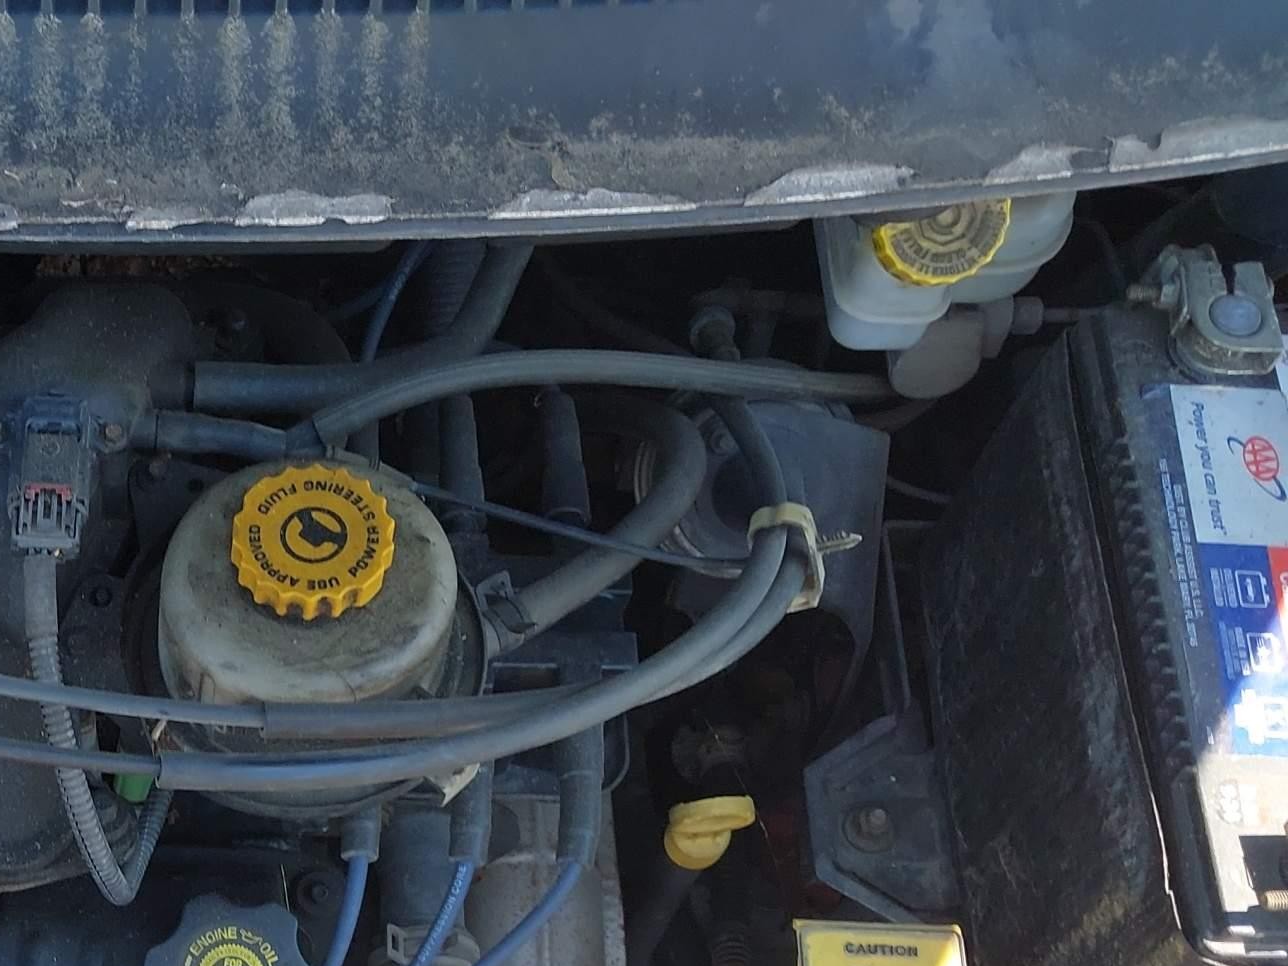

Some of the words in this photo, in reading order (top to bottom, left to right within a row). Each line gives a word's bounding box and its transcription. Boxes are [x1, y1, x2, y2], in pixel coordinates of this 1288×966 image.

[1191, 400, 1208, 445] Power
[1194, 442, 1213, 471] you
[258, 483, 297, 516] FLUID
[1203, 472, 1217, 496] can
[303, 480, 376, 522] STEERING
[248, 524, 300, 587] APPROVED
[348, 526, 380, 578] POWER
[307, 576, 340, 591] USE
[190, 926, 238, 956] ENGINE
[843, 941, 919, 957] CAUTION
